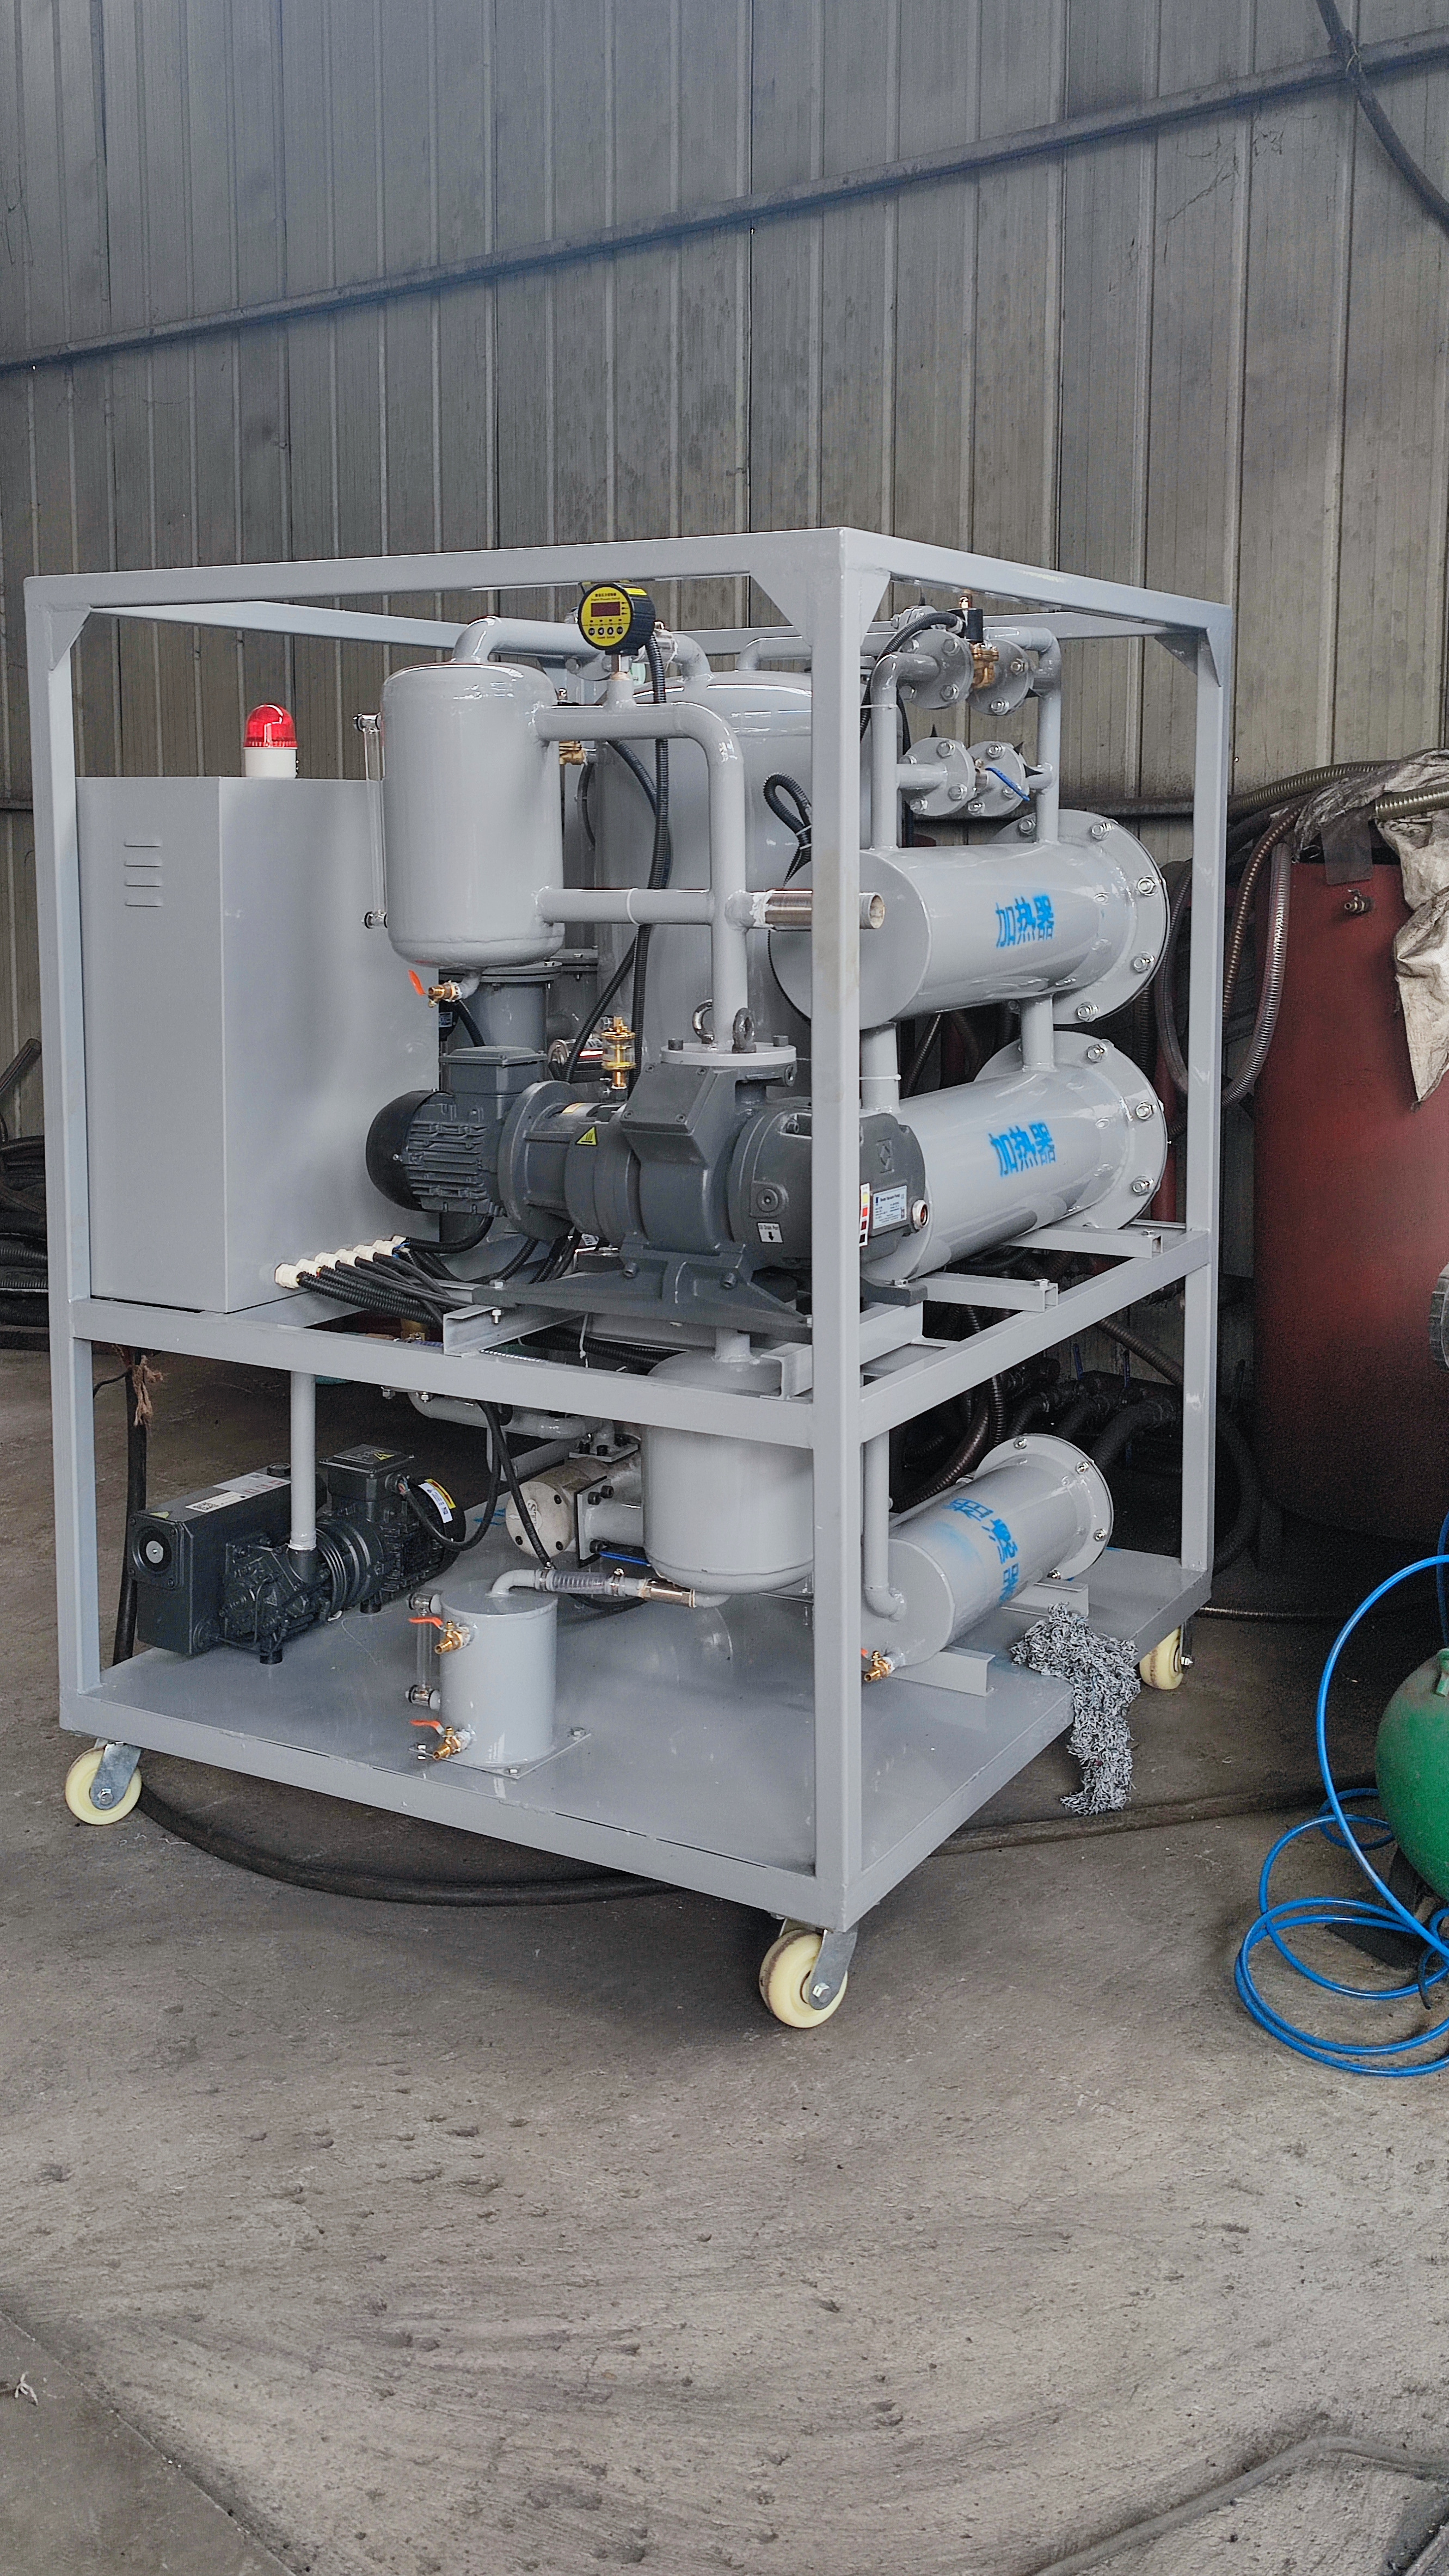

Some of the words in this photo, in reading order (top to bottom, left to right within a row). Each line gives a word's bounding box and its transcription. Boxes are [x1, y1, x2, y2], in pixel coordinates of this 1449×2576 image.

[996, 895, 1054, 948] 加热器
[988, 1122, 1055, 1177] 加热器
